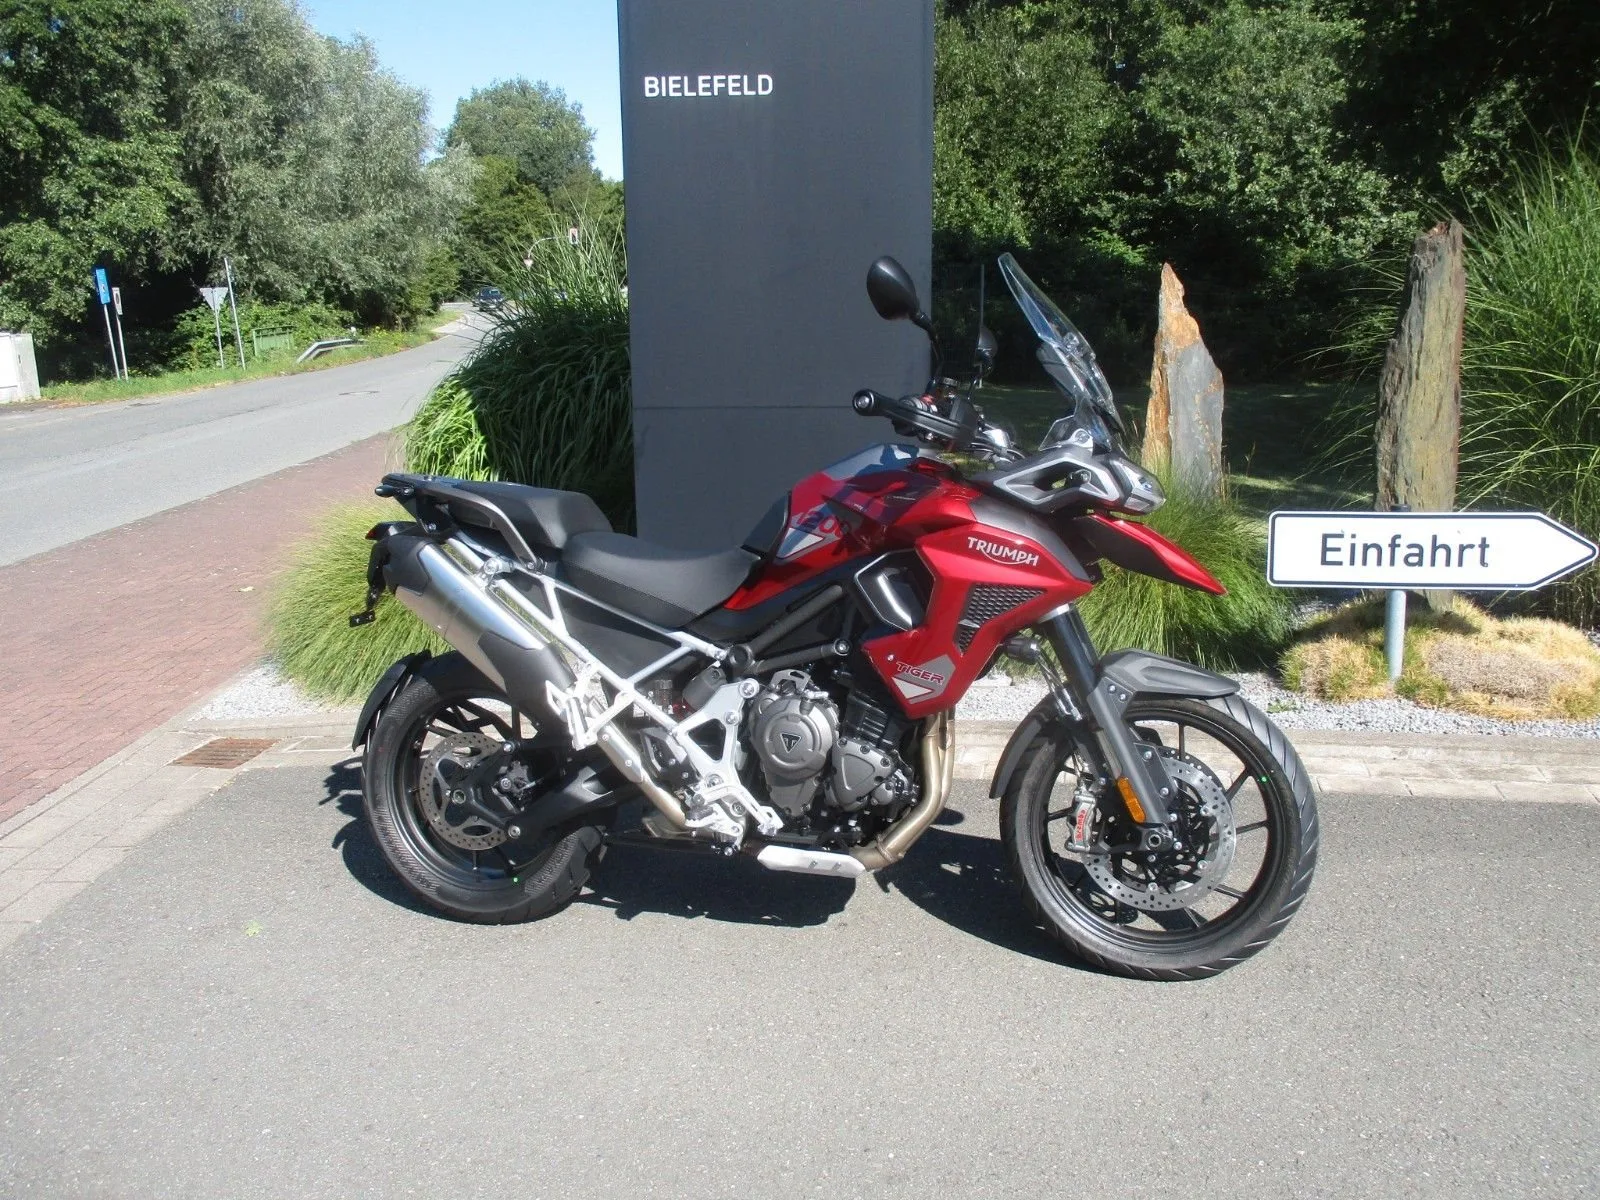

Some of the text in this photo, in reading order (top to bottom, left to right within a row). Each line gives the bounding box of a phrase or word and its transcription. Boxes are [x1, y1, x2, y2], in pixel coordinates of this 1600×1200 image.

[644, 74, 773, 97] BIELEFELD
[967, 537, 1039, 566] TRIUMPH
[1320, 533, 1490, 567] Einfahrt
[896, 661, 945, 685] TIGER
